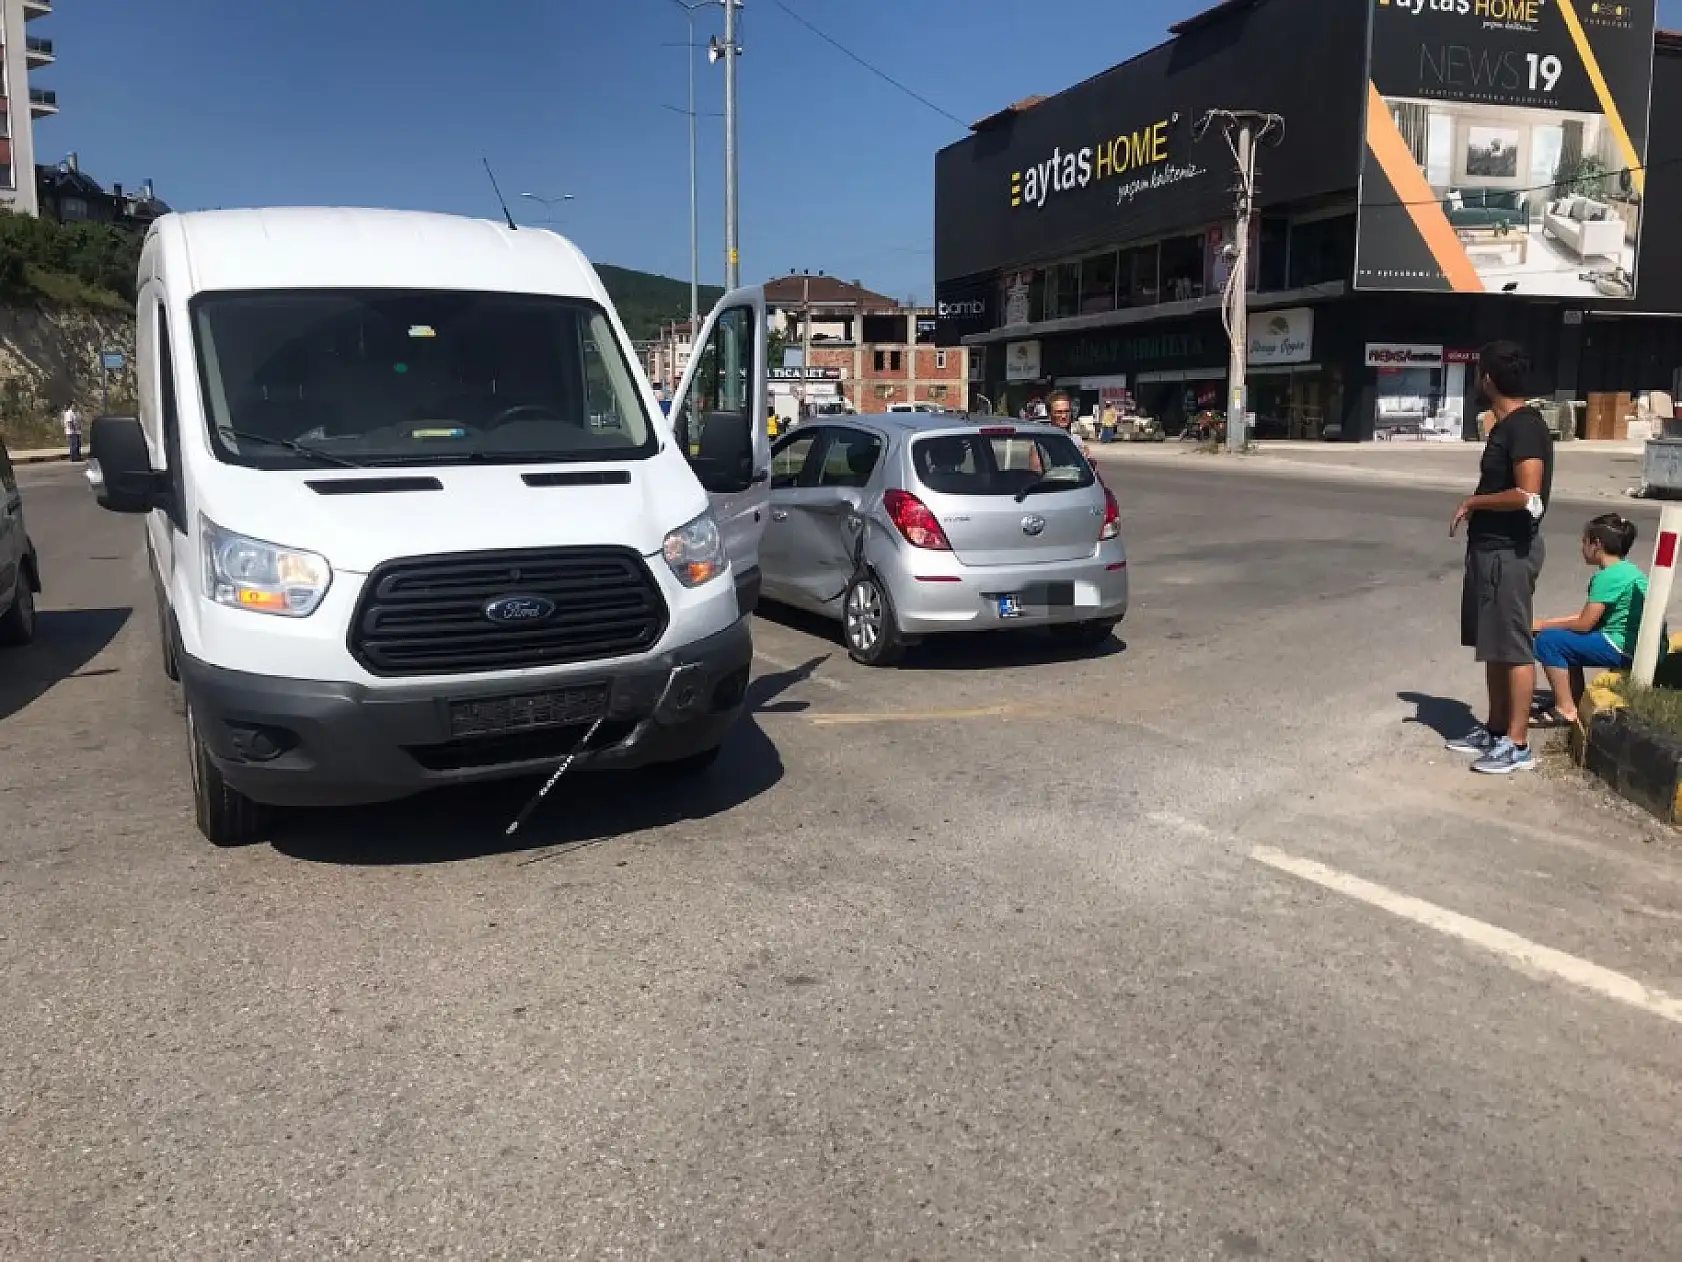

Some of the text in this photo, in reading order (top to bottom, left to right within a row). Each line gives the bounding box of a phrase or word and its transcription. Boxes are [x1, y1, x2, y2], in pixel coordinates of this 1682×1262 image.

[1474, 0, 1539, 22] HOME
[1418, 42, 1563, 92] NEWS 19
[1024, 119, 1168, 208] aytaş HOME
[504, 601, 540, 618] Ford
